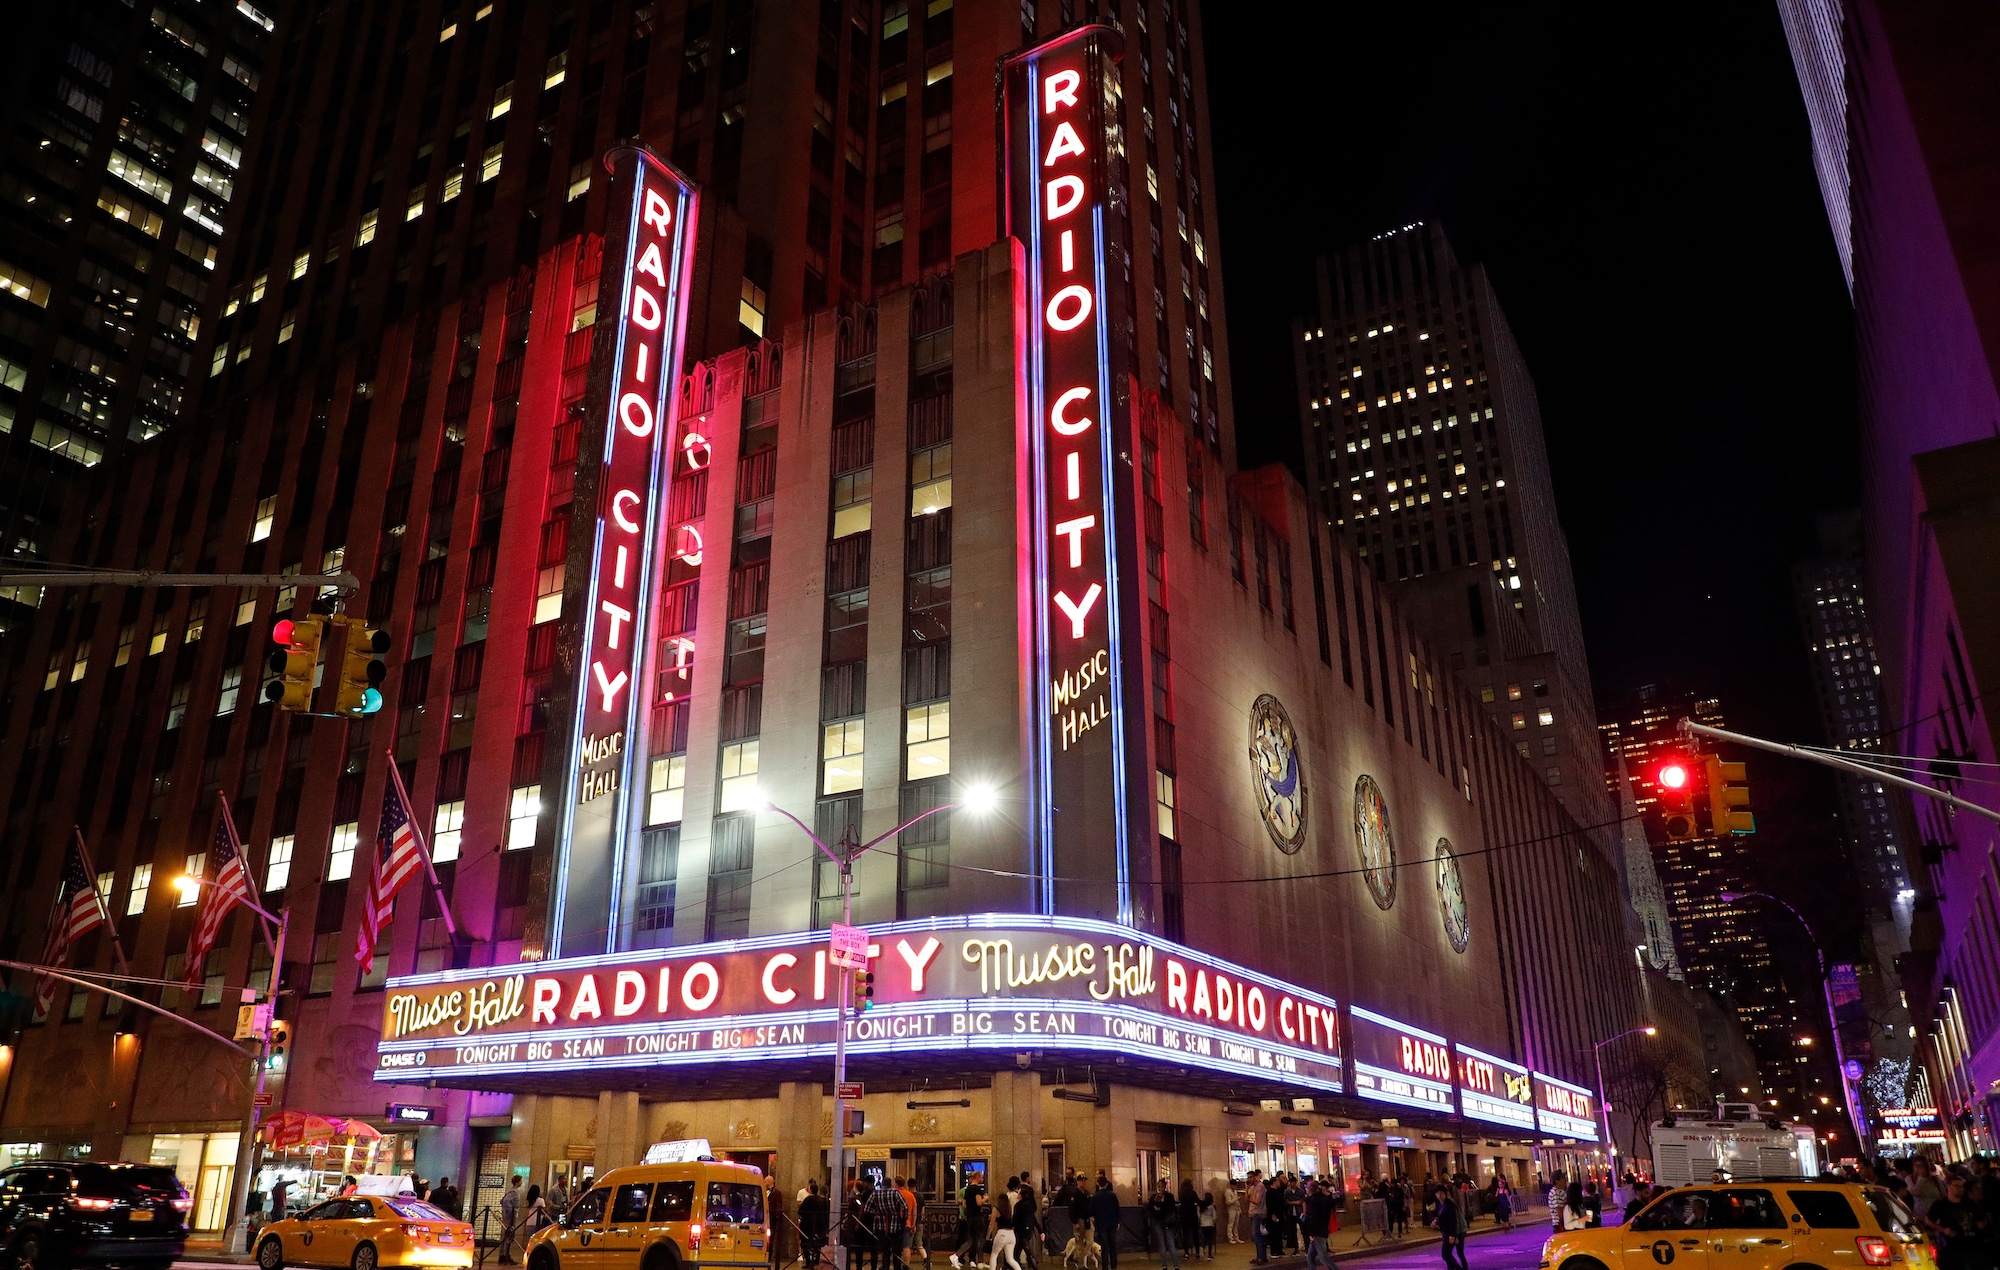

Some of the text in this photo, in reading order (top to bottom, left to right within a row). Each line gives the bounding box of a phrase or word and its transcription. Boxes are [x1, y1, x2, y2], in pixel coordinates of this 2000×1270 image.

[1044, 68, 1093, 332] RADIO
[619, 187, 671, 438] RADIO
[1050, 386, 1102, 639] CITY
[592, 489, 641, 713] CITY
[1050, 649, 1108, 715] MUSIC
[580, 731, 622, 768] MUSIC
[1061, 694, 1110, 751] HALL
[581, 769, 618, 804] HALL
[390, 936, 942, 1037] Music Hall RADIO CIY
[962, 938, 1336, 1050] Music Hall RADIO CITY
[381, 1053, 415, 1067] CHASE
[455, 1012, 1296, 1073] TONIGHT BIG SEAN TONIGHT BIG SEAN TONIGHT BIG SEAN TONIGHT BIG SEAN TONIGHT BIG SEAN
[1400, 1035, 1450, 1081] RADIO
[1466, 1057, 1495, 1093] CITY
[1545, 1084, 1572, 1114] RADIO
[1573, 1092, 1590, 1118] CITY
[1882, 1128, 1918, 1139] NBC
